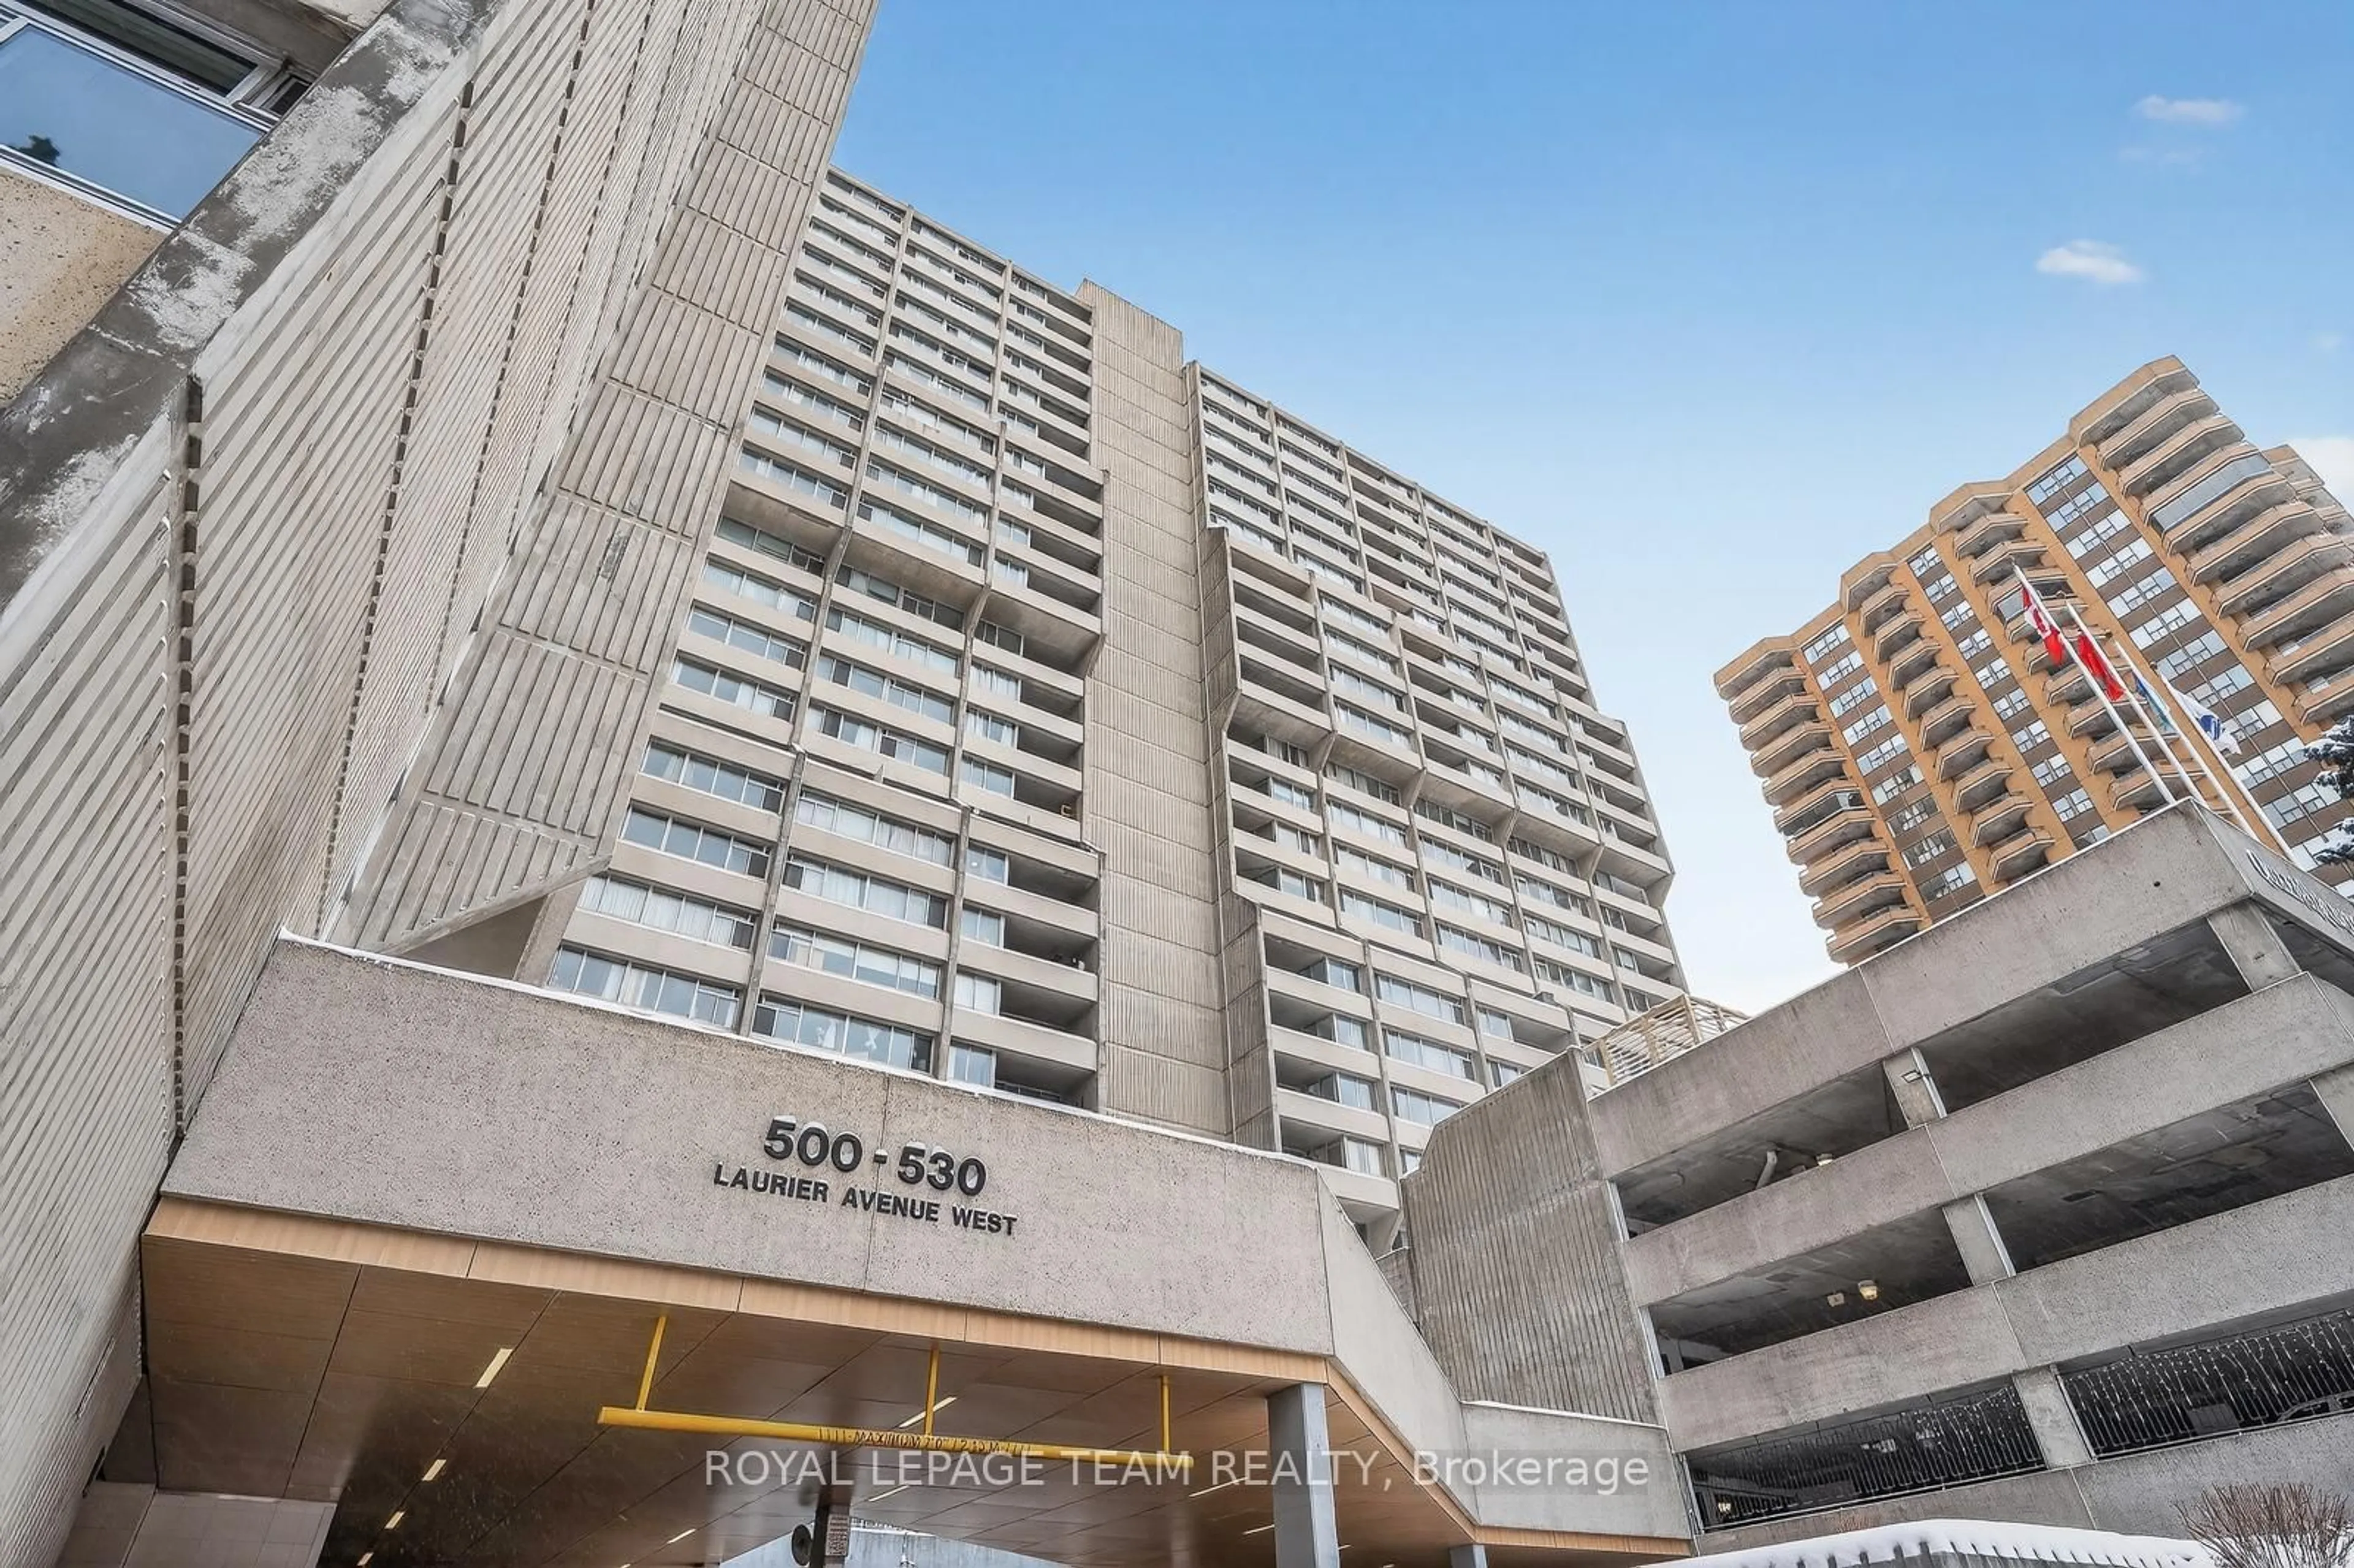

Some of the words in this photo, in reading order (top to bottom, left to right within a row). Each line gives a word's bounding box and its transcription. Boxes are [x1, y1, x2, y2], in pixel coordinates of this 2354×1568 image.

[764, 1116, 863, 1173] 500
[897, 1143, 986, 1196] 530
[714, 1162, 829, 1203] LAURIER
[841, 1187, 940, 1222] AVENUE
[952, 1205, 1018, 1236] WEST
